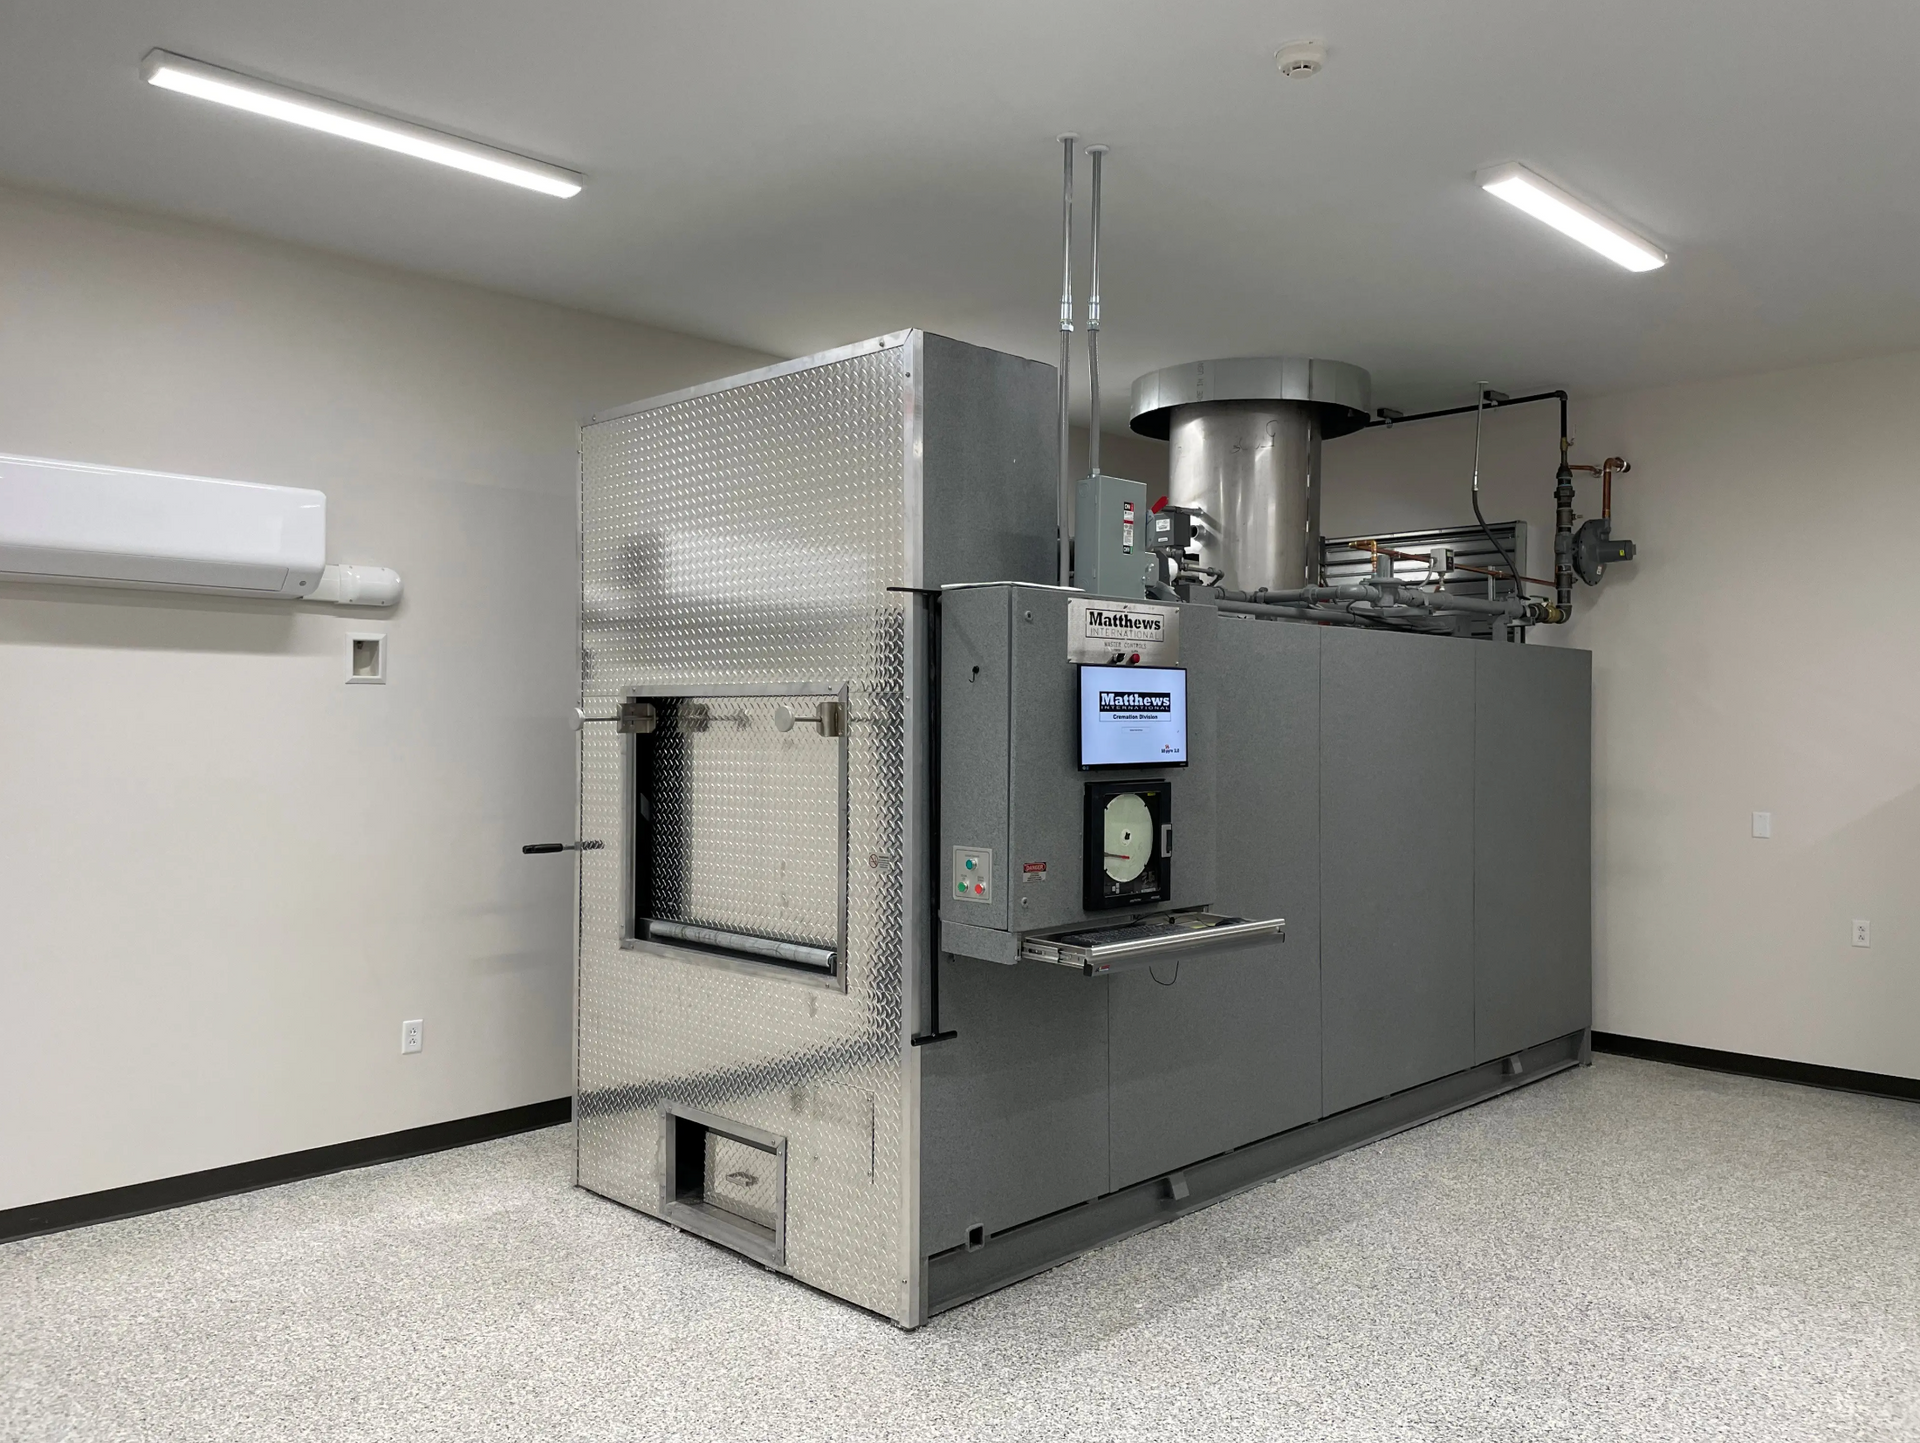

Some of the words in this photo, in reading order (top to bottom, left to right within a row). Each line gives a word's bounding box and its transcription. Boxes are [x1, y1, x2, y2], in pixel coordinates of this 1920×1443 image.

[1089, 611, 1161, 630] Matthews
[1090, 627, 1160, 640] INTERNATIONAL
[1124, 642, 1147, 650] CONTROLS
[1100, 693, 1170, 706] Matthews
